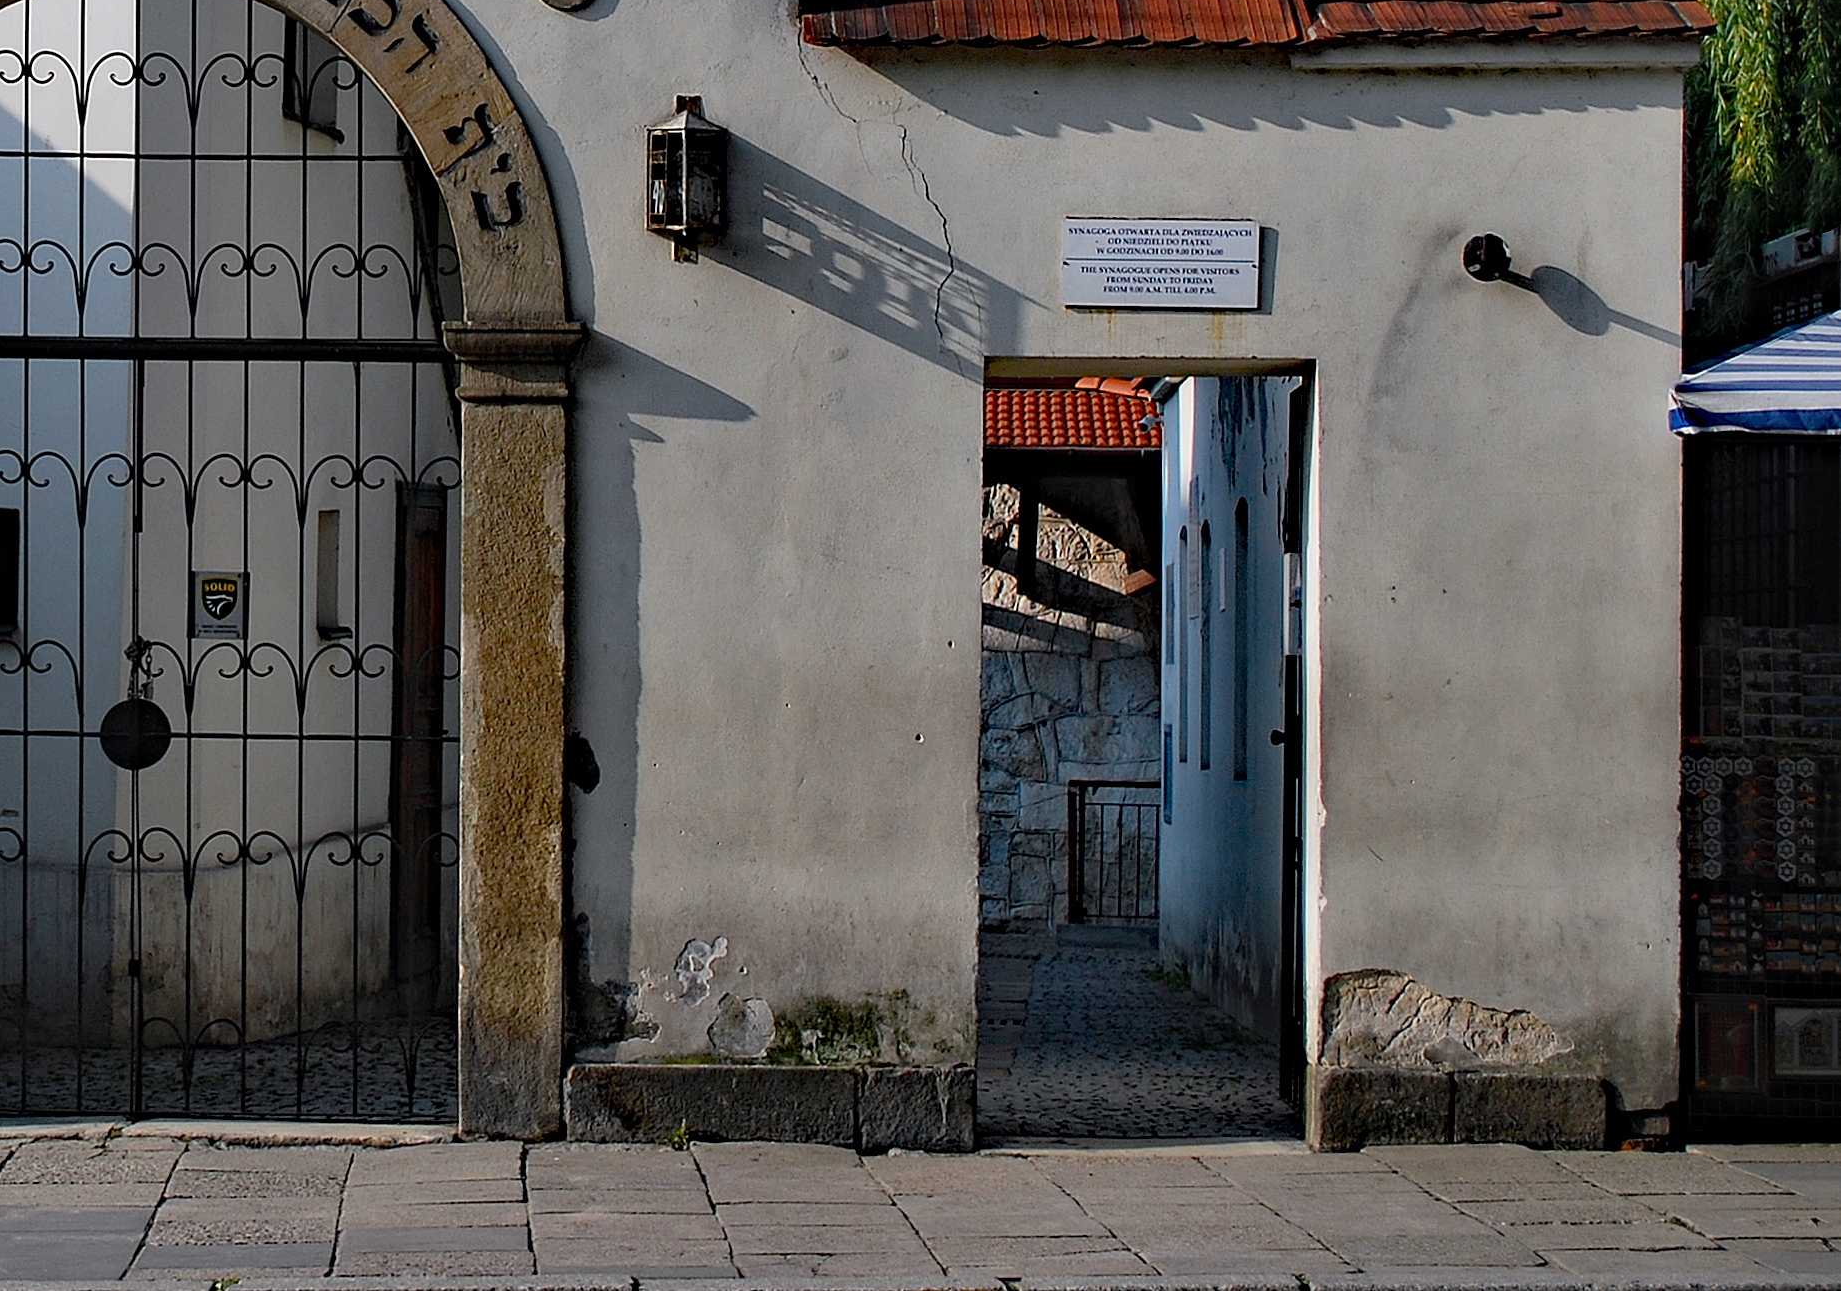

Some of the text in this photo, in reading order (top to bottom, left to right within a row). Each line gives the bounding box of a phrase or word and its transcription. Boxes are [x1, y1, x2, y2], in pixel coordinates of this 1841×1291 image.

[1068, 227, 1116, 236] SYNAGOGA
[1118, 228, 1160, 236] OTWARTA
[1123, 238, 1164, 246] NIEDZIELI
[1166, 238, 1179, 246] DO
[1096, 247, 1104, 255] W
[1106, 247, 1159, 255] GODZINACH
[1191, 248, 1204, 256] DO
[1099, 266, 1151, 274] SYNAGOGUE
[1132, 276, 1167, 284] SUNDAY
[203, 582, 236, 592] SOLID
